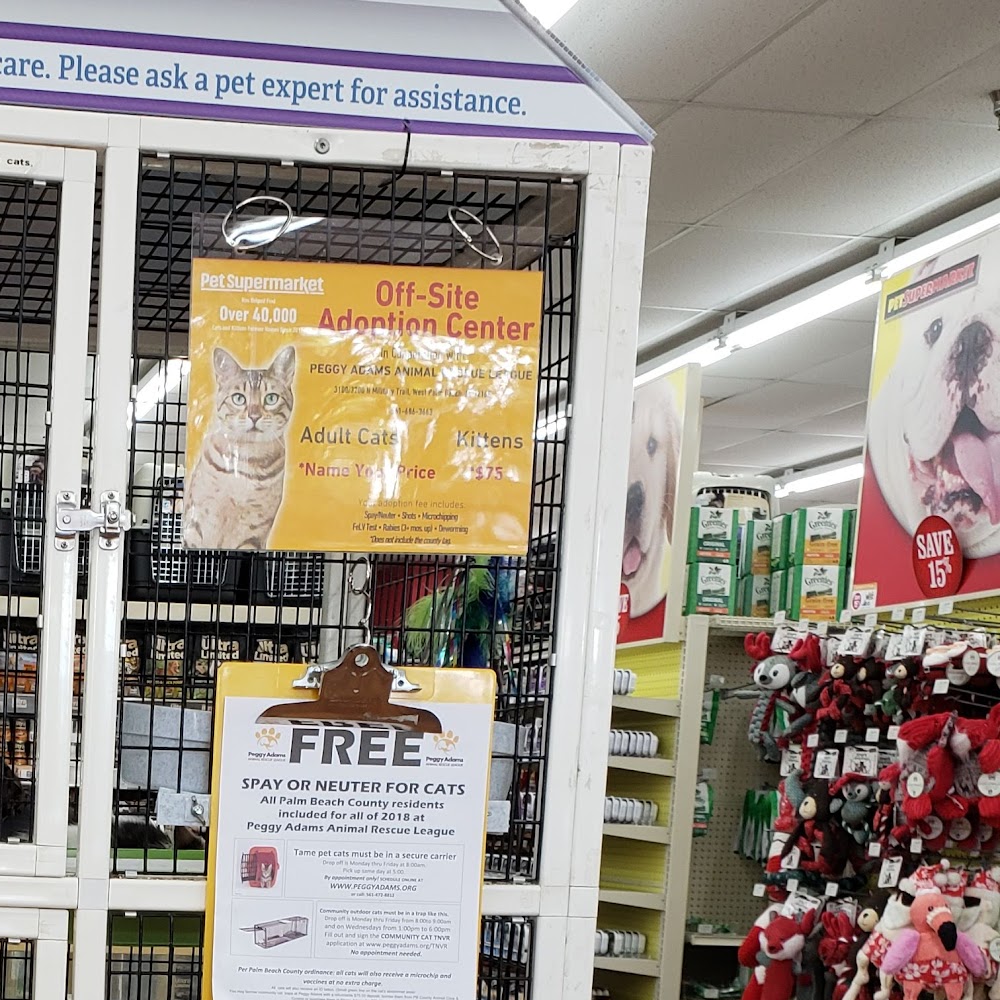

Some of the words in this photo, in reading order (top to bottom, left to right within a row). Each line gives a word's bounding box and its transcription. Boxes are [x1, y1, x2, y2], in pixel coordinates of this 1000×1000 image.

[58, 55, 139, 85] Please
[146, 63, 188, 89] ask
[195, 73, 208, 91] a
[215, 72, 255, 99] pet
[262, 78, 344, 105] expert
[350, 78, 387, 105] for
[394, 89, 526, 115] assistance.
[201, 272, 225, 288] Pet
[227, 274, 324, 294] Supermarket
[376, 280, 479, 309] Off-Site
[220, 306, 249, 322] Over
[253, 307, 297, 324] 40,000
[446, 312, 535, 341] Center
[310, 364, 347, 375] PEGGY
[351, 365, 391, 376] ADAMS
[395, 366, 436, 378] ANIMAL
[300, 426, 351, 445] Adult
[357, 428, 399, 446] Cats
[457, 430, 523, 449] Kittens
[916, 529, 954, 559] SAVE
[248, 751, 266, 759] Peggy
[289, 728, 424, 767] FREE
[426, 756, 444, 764] Peggy
[242, 778, 283, 790] SPAY
[287, 780, 310, 790] OR
[316, 781, 381, 792] NEUTER
[386, 783, 419, 794] FOR
[424, 784, 465, 795] CATS
[260, 796, 276, 804] All
[280, 797, 306, 805] Palm
[311, 798, 344, 806] Beach
[348, 799, 389, 810] County
[392, 800, 444, 809] residents
[279, 810, 327, 818] included
[331, 811, 347, 819] for
[367, 812, 378, 820] of
[381, 813, 409, 821] 2018
[247, 822, 282, 833] Peggy
[285, 823, 323, 831] Adams
[327, 825, 367, 833] Animal
[371, 826, 410, 834] Rescue
[414, 827, 454, 837] League
